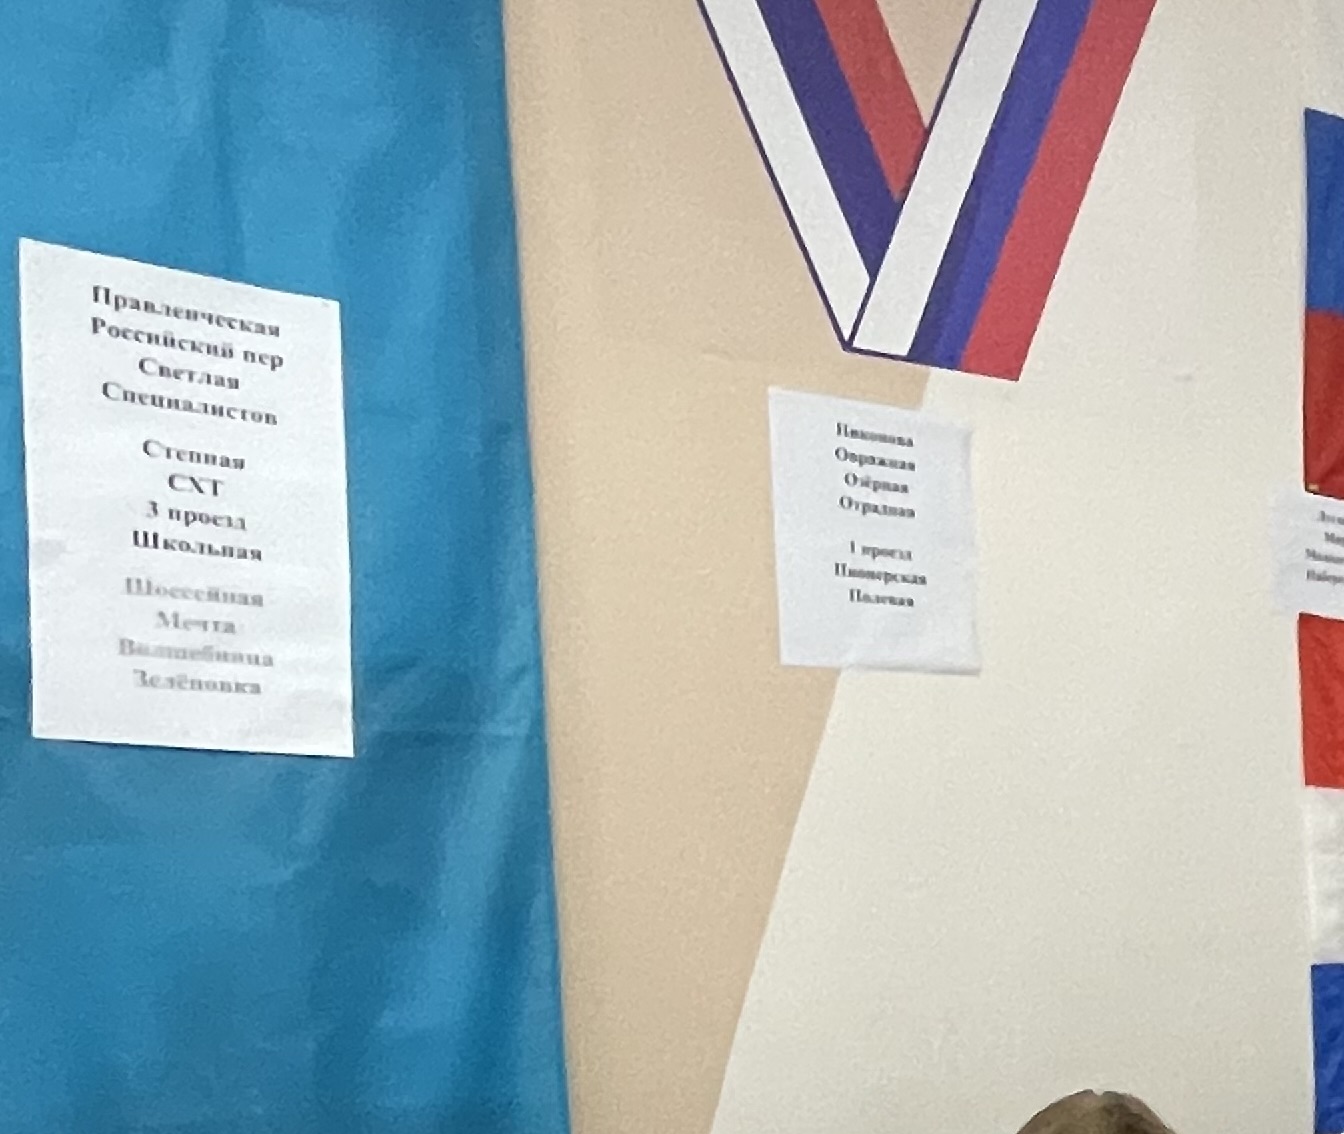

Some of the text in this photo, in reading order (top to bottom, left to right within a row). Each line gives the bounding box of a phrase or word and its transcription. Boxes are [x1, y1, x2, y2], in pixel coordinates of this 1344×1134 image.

[92, 284, 280, 338] Правленческая
[90, 316, 284, 372] Российский пер
[138, 356, 241, 390] Светлая
[102, 380, 279, 426] Специалистов
[142, 438, 246, 470] Степная
[168, 472, 225, 497] СХТ
[145, 500, 248, 532] 3 проезд
[132, 529, 263, 562] Школьная
[124, 576, 264, 608] Шоссейная
[157, 610, 238, 634] Мечта
